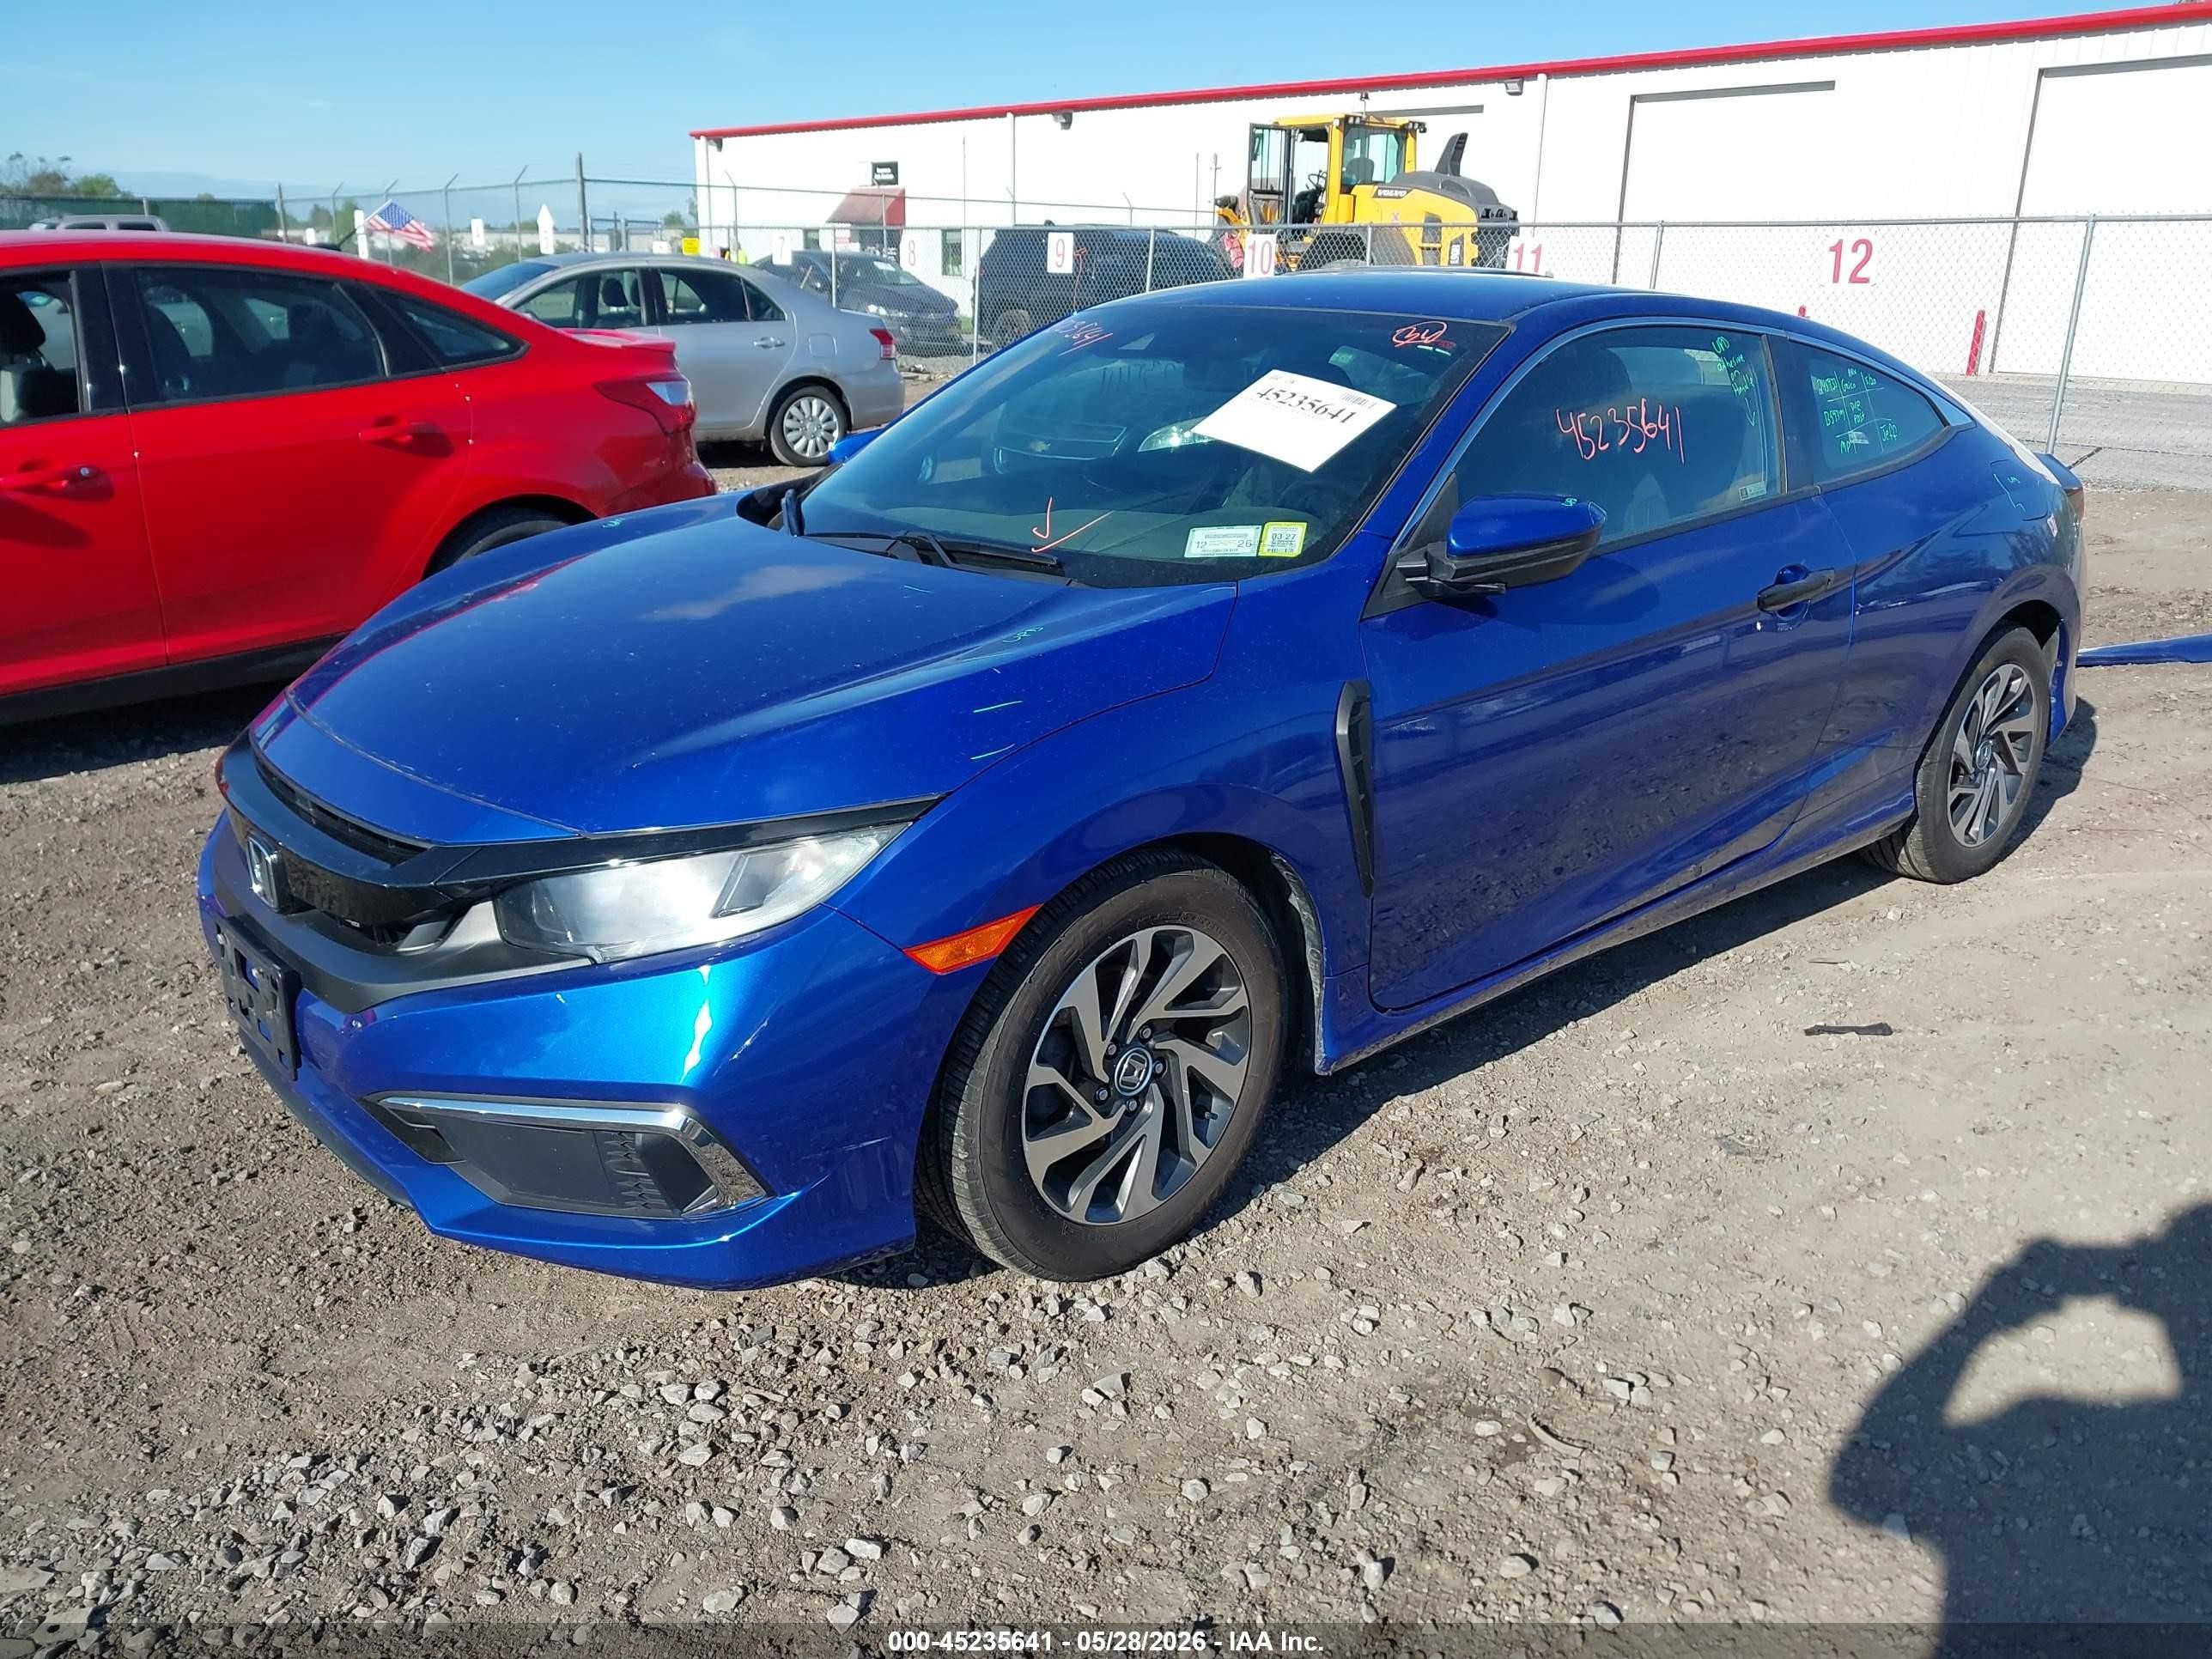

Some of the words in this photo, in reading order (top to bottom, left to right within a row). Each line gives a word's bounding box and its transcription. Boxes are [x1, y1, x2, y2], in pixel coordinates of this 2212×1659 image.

[908, 240, 916, 266] 8
[1054, 238, 1066, 269] 9
[1249, 240, 1273, 276] 10
[1513, 242, 1543, 274] 11
[1828, 239, 1874, 283] 12
[1256, 386, 1358, 424] 45235641
[1556, 398, 1686, 465] 45235641
[1194, 540, 1208, 550] 12
[1237, 539, 1253, 549] 26
